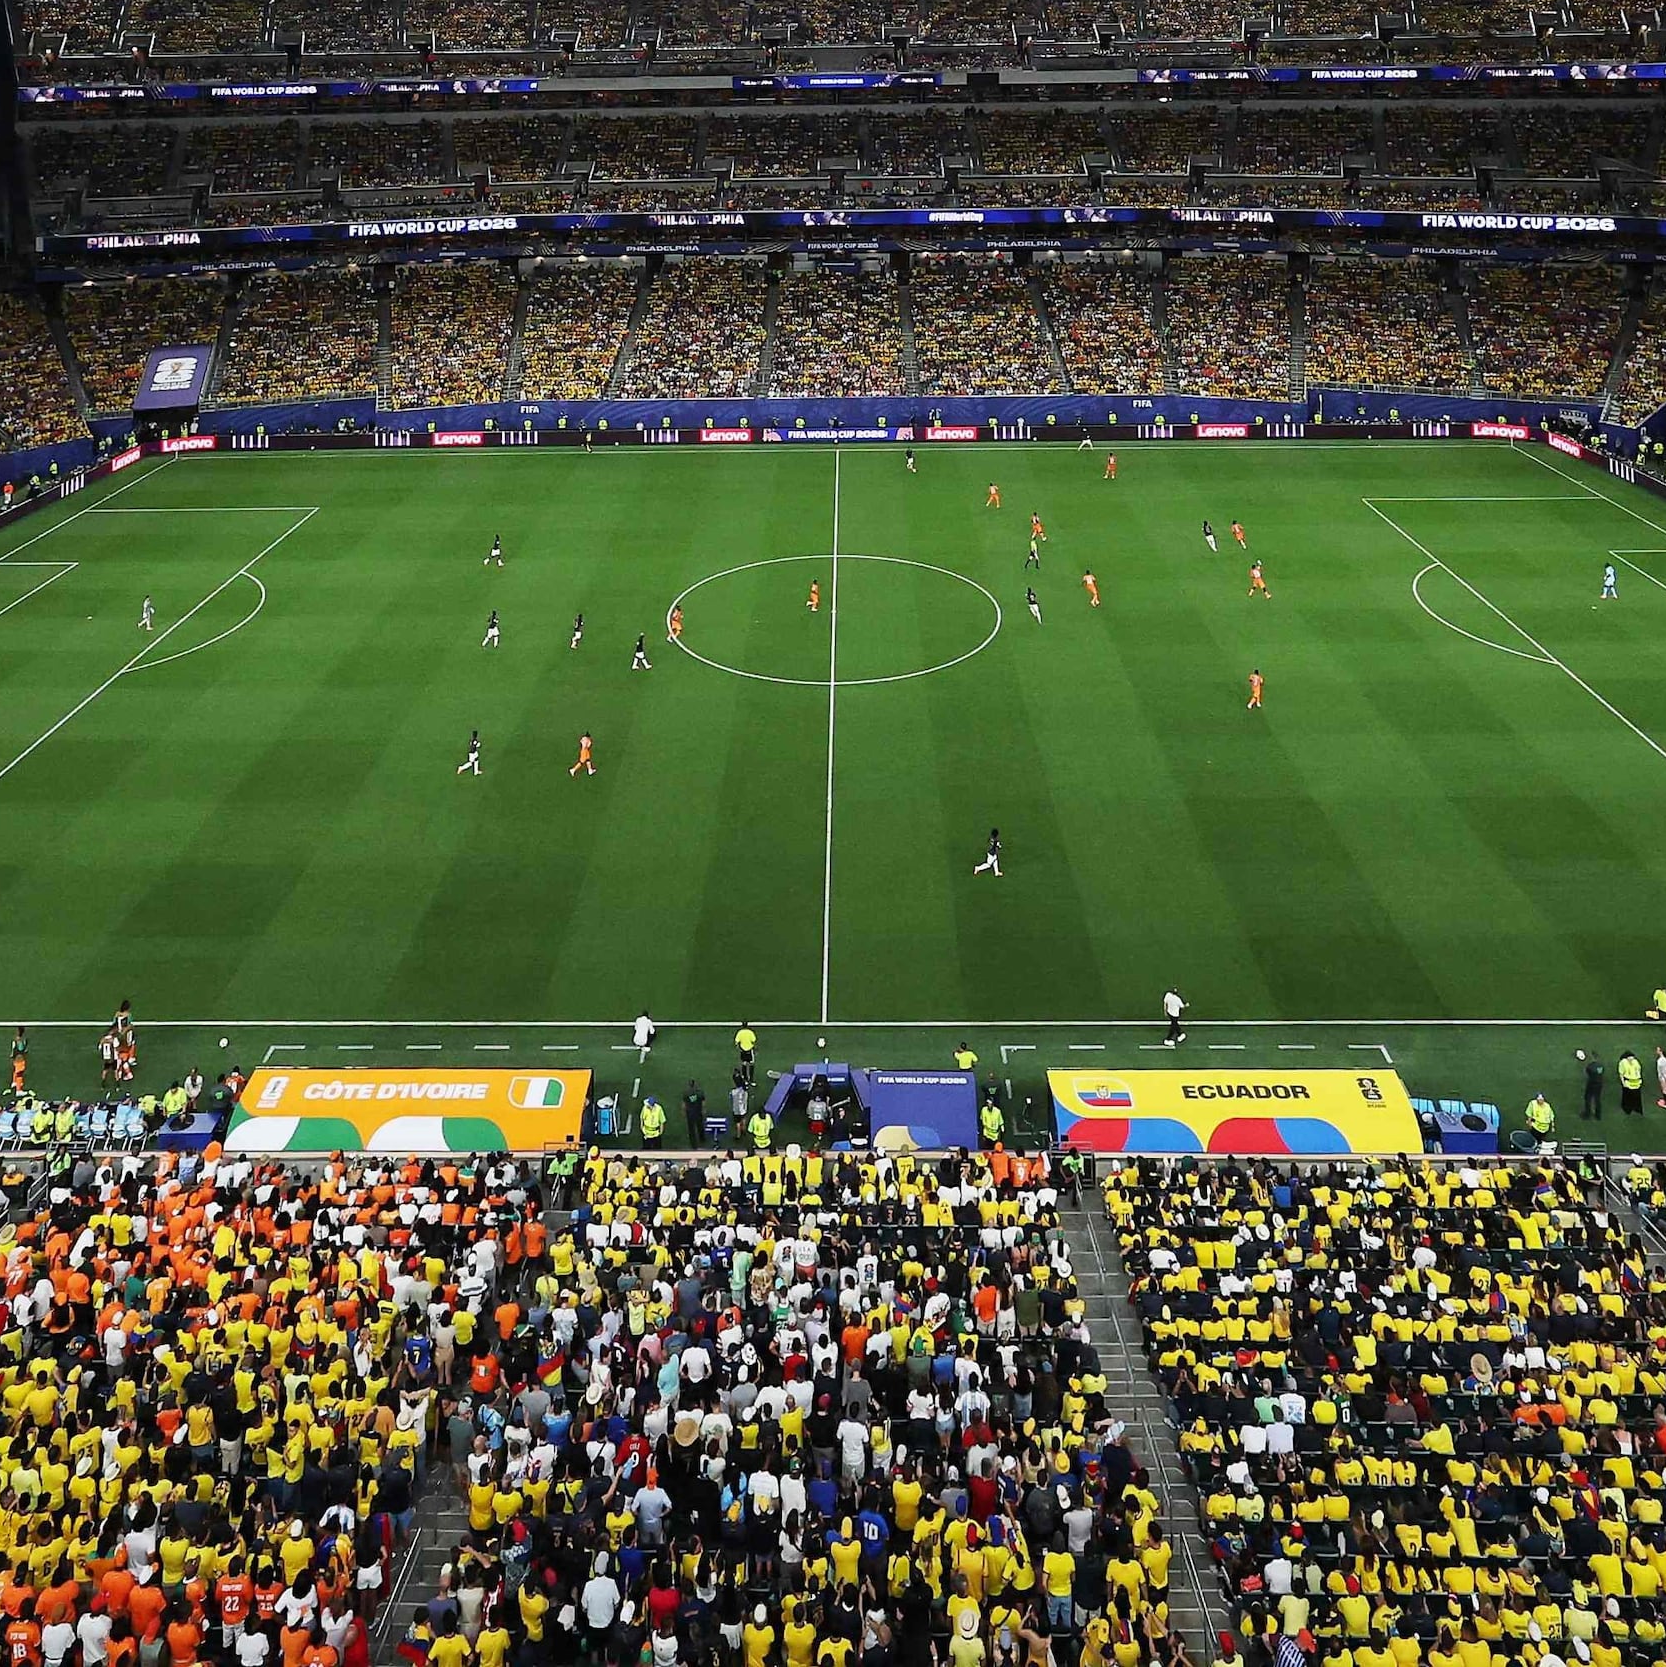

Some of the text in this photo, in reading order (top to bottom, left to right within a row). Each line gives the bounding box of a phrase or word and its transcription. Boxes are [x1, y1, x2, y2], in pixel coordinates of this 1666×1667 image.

[1189, 72, 1249, 80] PHILADLPHIA
[1312, 69, 1418, 79] FIFA WORLD CUP 2026
[1486, 68, 1555, 77] PHILADLPHIA
[78, 88, 145, 99] PHILADLPHIA
[211, 85, 318, 96] FIFA WORLD CUP 2026
[379, 83, 440, 92] PHILADLPHIA
[646, 213, 745, 226] PHILADLPHIA
[1421, 214, 1615, 232] FIFA WORLD CUP 2026
[348, 217, 517, 237] FIFA WORLD CUP 2026
[86, 232, 201, 249] PHILADELPHIA
[986, 239, 1062, 248] PHILADELPHIA
[626, 245, 700, 253] PHILADELPHIA
[1411, 246, 1499, 256] PHILADELPHIA
[520, 405, 540, 414] FIFA
[1133, 399, 1153, 409] FIFA
[702, 430, 748, 442] Lenovo
[788, 430, 806, 439] FIFA
[806, 430, 833, 439] WORLD
[837, 430, 855, 438] CUP
[928, 429, 974, 439] Lenovo
[1198, 425, 1246, 437] Lenovo
[1473, 423, 1526, 438] Lenovo
[162, 438, 214, 452] Lenovo
[434, 434, 481, 445] Lenovo
[1549, 434, 1581, 457] Lenovo
[111, 448, 141, 472] Lenovo
[877, 1076, 895, 1084] FIFA
[303, 1080, 490, 1100] CÔTE D'IVOIRE
[1181, 1085, 1311, 1099] ECUADOR
[413, 1348, 421, 1364] 7
[631, 1451, 639, 1467] 9
[864, 1522, 878, 1540] 10
[224, 1595, 240, 1612] 22
[12, 1643, 27, 1659] 18
